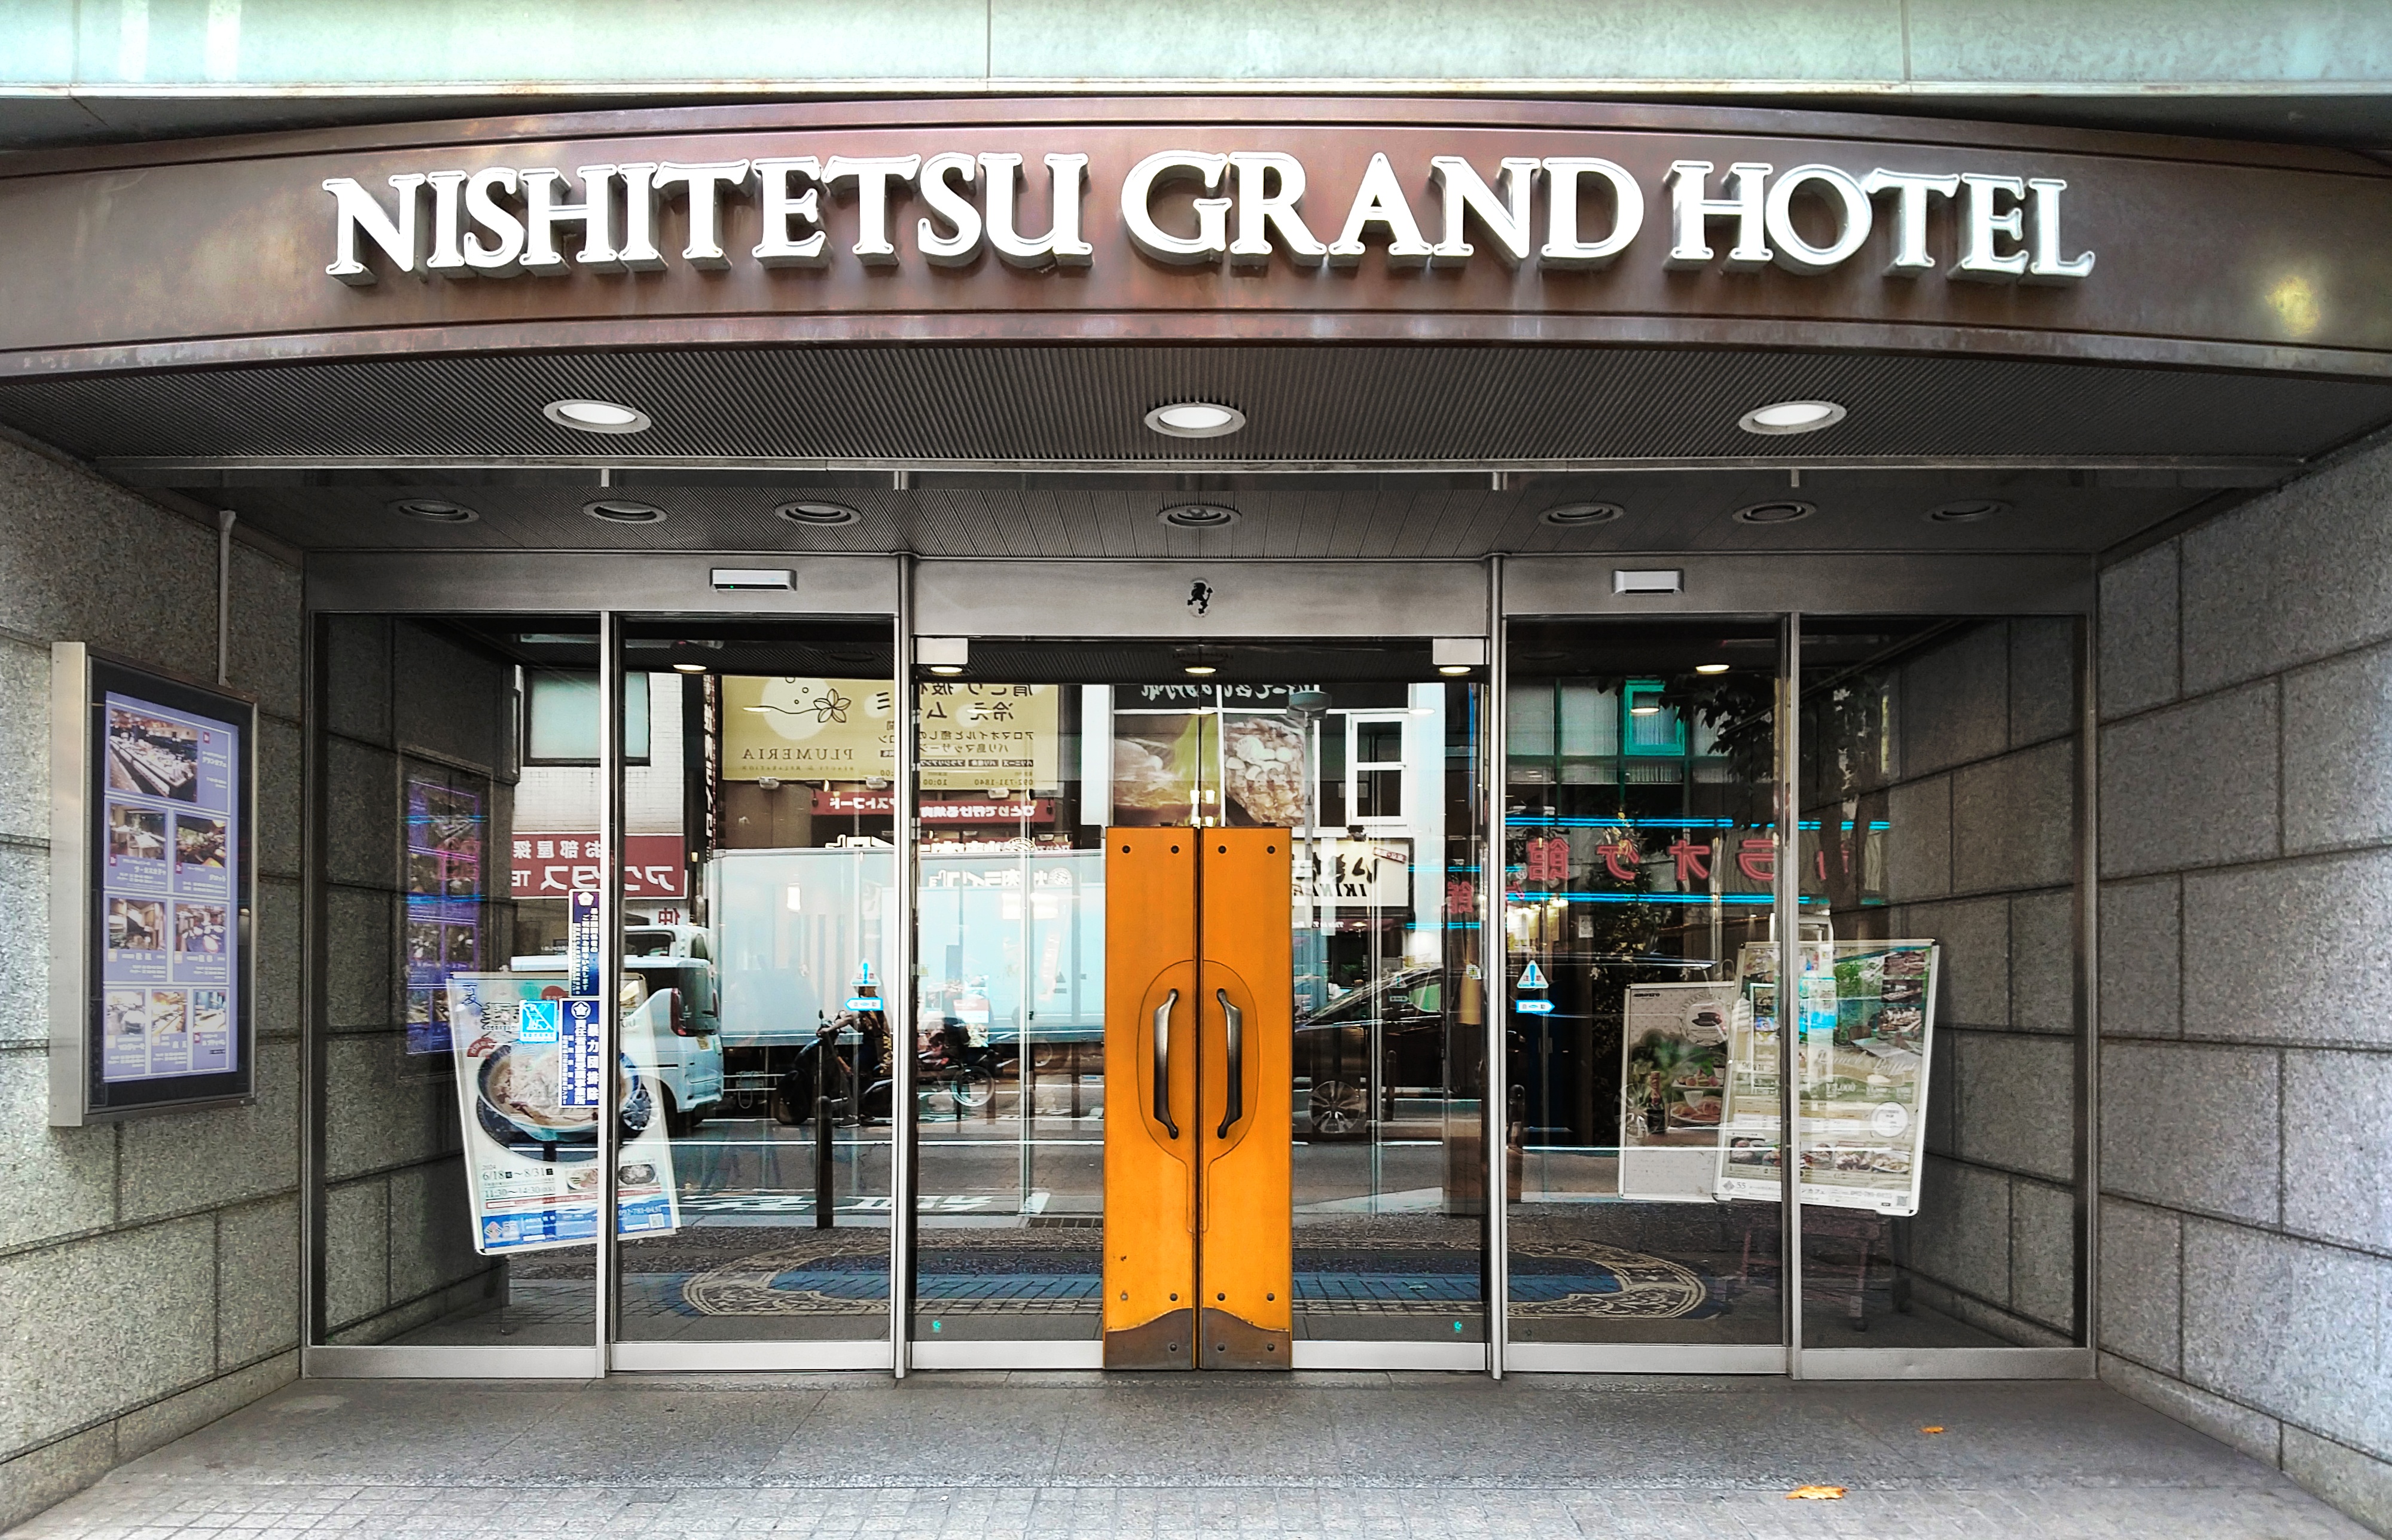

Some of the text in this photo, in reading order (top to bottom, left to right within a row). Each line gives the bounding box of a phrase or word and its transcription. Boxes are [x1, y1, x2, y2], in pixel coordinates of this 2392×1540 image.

[322, 151, 2097, 282] NISHITETSU GRAND HOTEL
